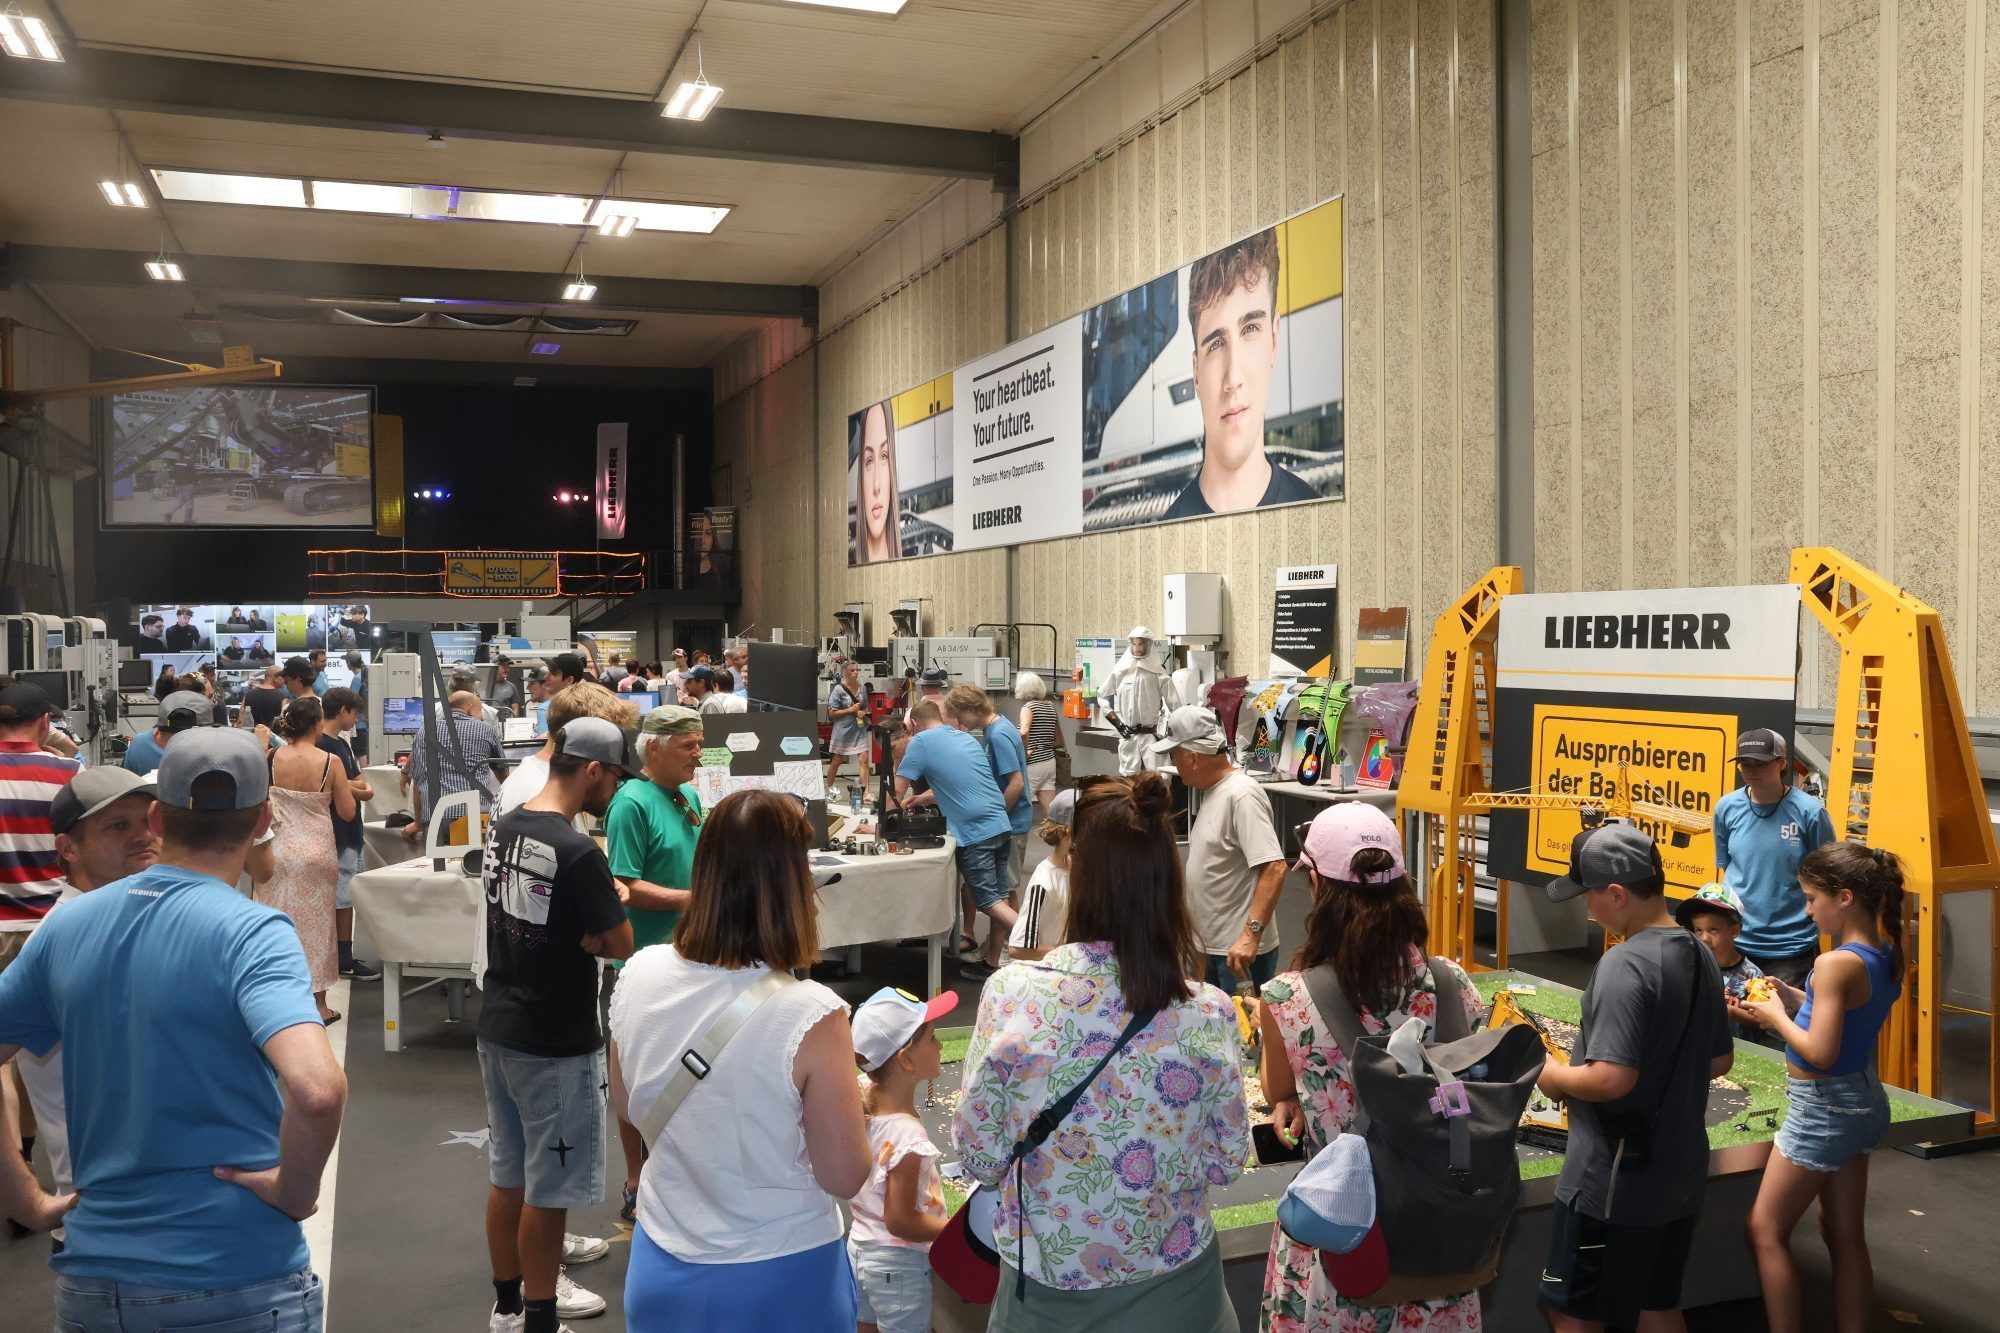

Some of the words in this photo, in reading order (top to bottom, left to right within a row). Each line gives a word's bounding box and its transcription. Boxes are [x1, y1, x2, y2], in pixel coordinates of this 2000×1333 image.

[973, 389, 996, 415] Your
[998, 362, 1055, 406] heartbeat.
[973, 423, 996, 448] Your
[998, 411, 1034, 441] future.
[608, 448, 618, 519] LIEBHERR
[972, 475, 981, 487] One
[1000, 468, 1011, 481] Many
[1012, 460, 1045, 479] Opportunities.
[973, 505, 1022, 531] LIEBHERR
[1287, 569, 1325, 581] LIEBHERR
[936, 645, 947, 653] AB
[948, 644, 969, 653] 34/SV
[1545, 612, 1731, 650] LIEBHERR
[1554, 733, 1706, 773] Ausprobieren
[1548, 768, 1583, 795] der
[1589, 771, 1711, 813] Bastellen
[1361, 834, 1382, 842] POLO
[1780, 821, 1798, 840] 50
[1547, 838, 1560, 850] Das
[1561, 841, 1571, 853] gil
[1662, 858, 1675, 871] für
[1677, 860, 1705, 876] Kinder
